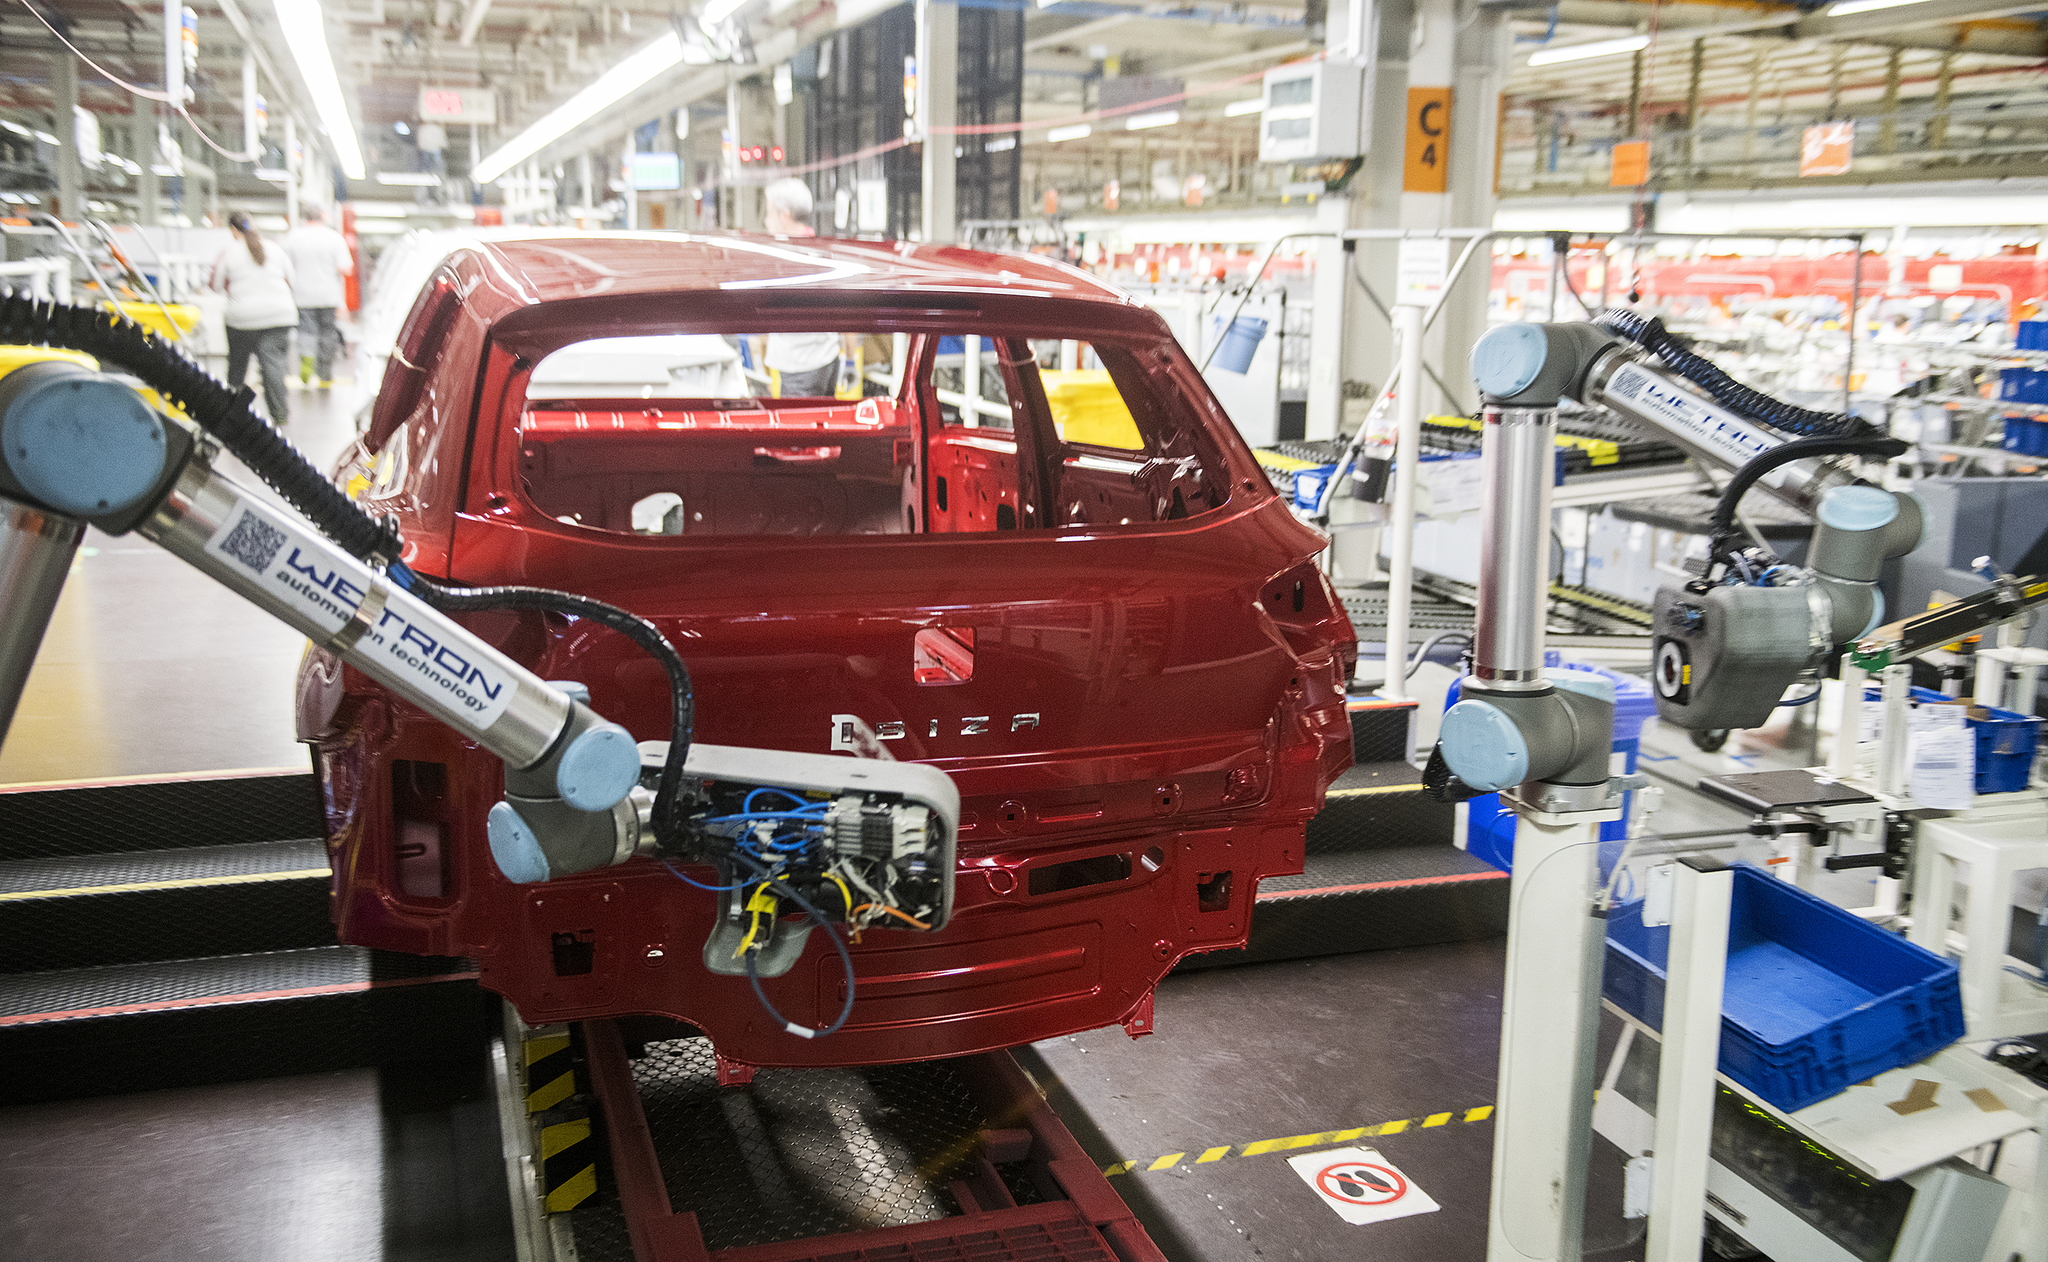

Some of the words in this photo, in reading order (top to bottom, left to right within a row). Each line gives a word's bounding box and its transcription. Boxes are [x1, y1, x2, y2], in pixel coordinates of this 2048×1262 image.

[1420, 100, 1442, 137] C
[1420, 142, 1437, 169] 4
[286, 547, 503, 701] WETRON
[389, 641, 489, 712] technology
